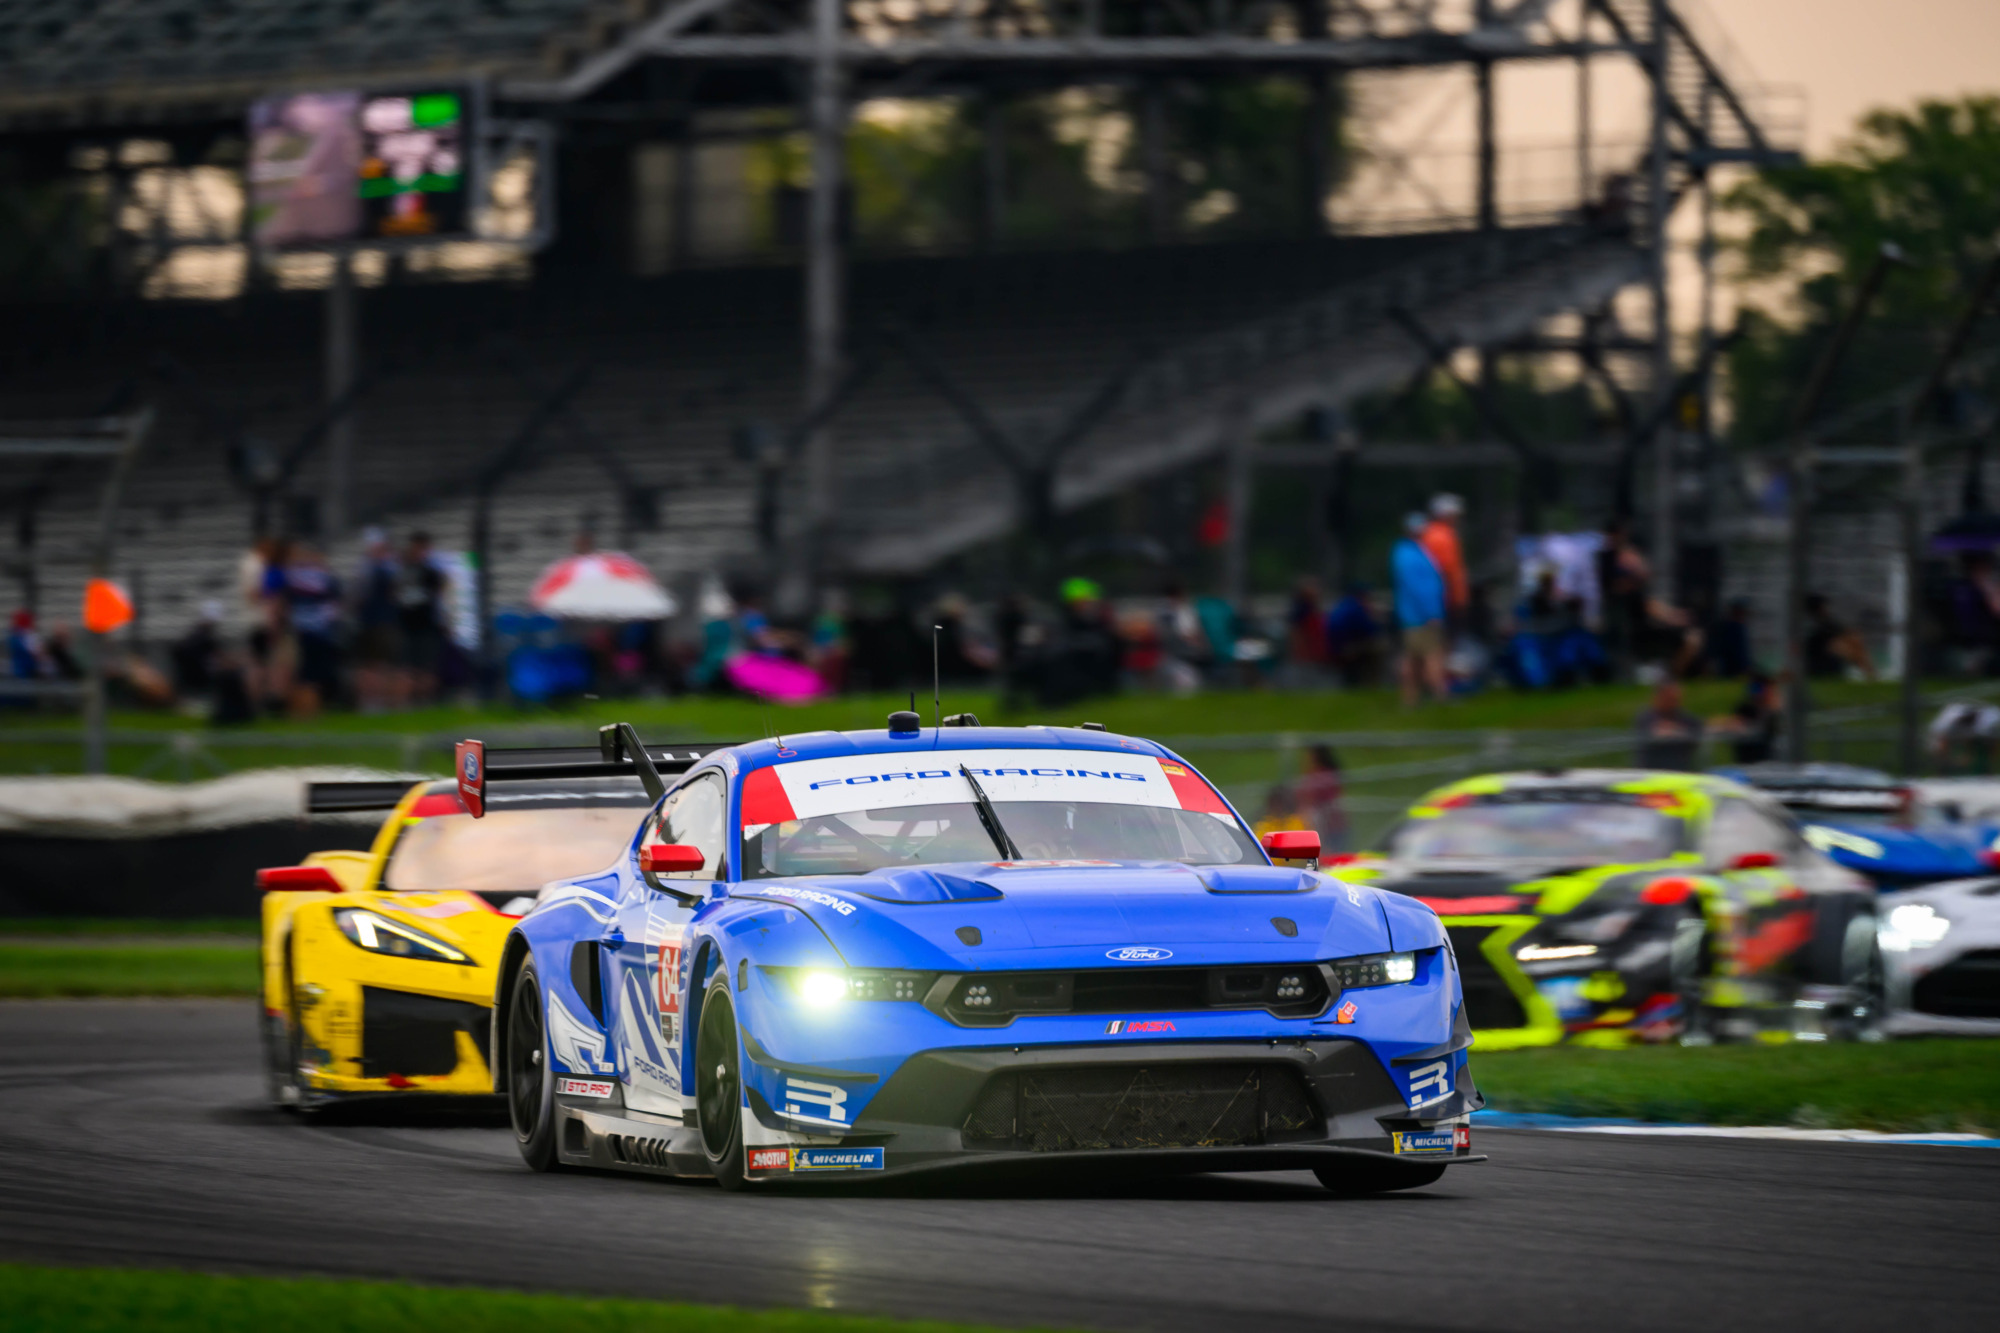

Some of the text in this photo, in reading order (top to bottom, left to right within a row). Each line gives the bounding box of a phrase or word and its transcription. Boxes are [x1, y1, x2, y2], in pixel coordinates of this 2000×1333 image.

[809, 770, 952, 790] FORD
[958, 768, 1146, 782] RACING
[760, 887, 857, 916] FORD RACING
[1119, 949, 1160, 959] Ford
[662, 948, 680, 1006] 64
[1127, 1021, 1176, 1033] IMSA
[634, 1056, 658, 1080] FORD
[567, 1081, 611, 1096] GTD PRO
[1414, 1137, 1453, 1147] MICHELIN
[753, 1152, 787, 1167] MOTUL
[812, 1154, 875, 1164] MICHELIN
